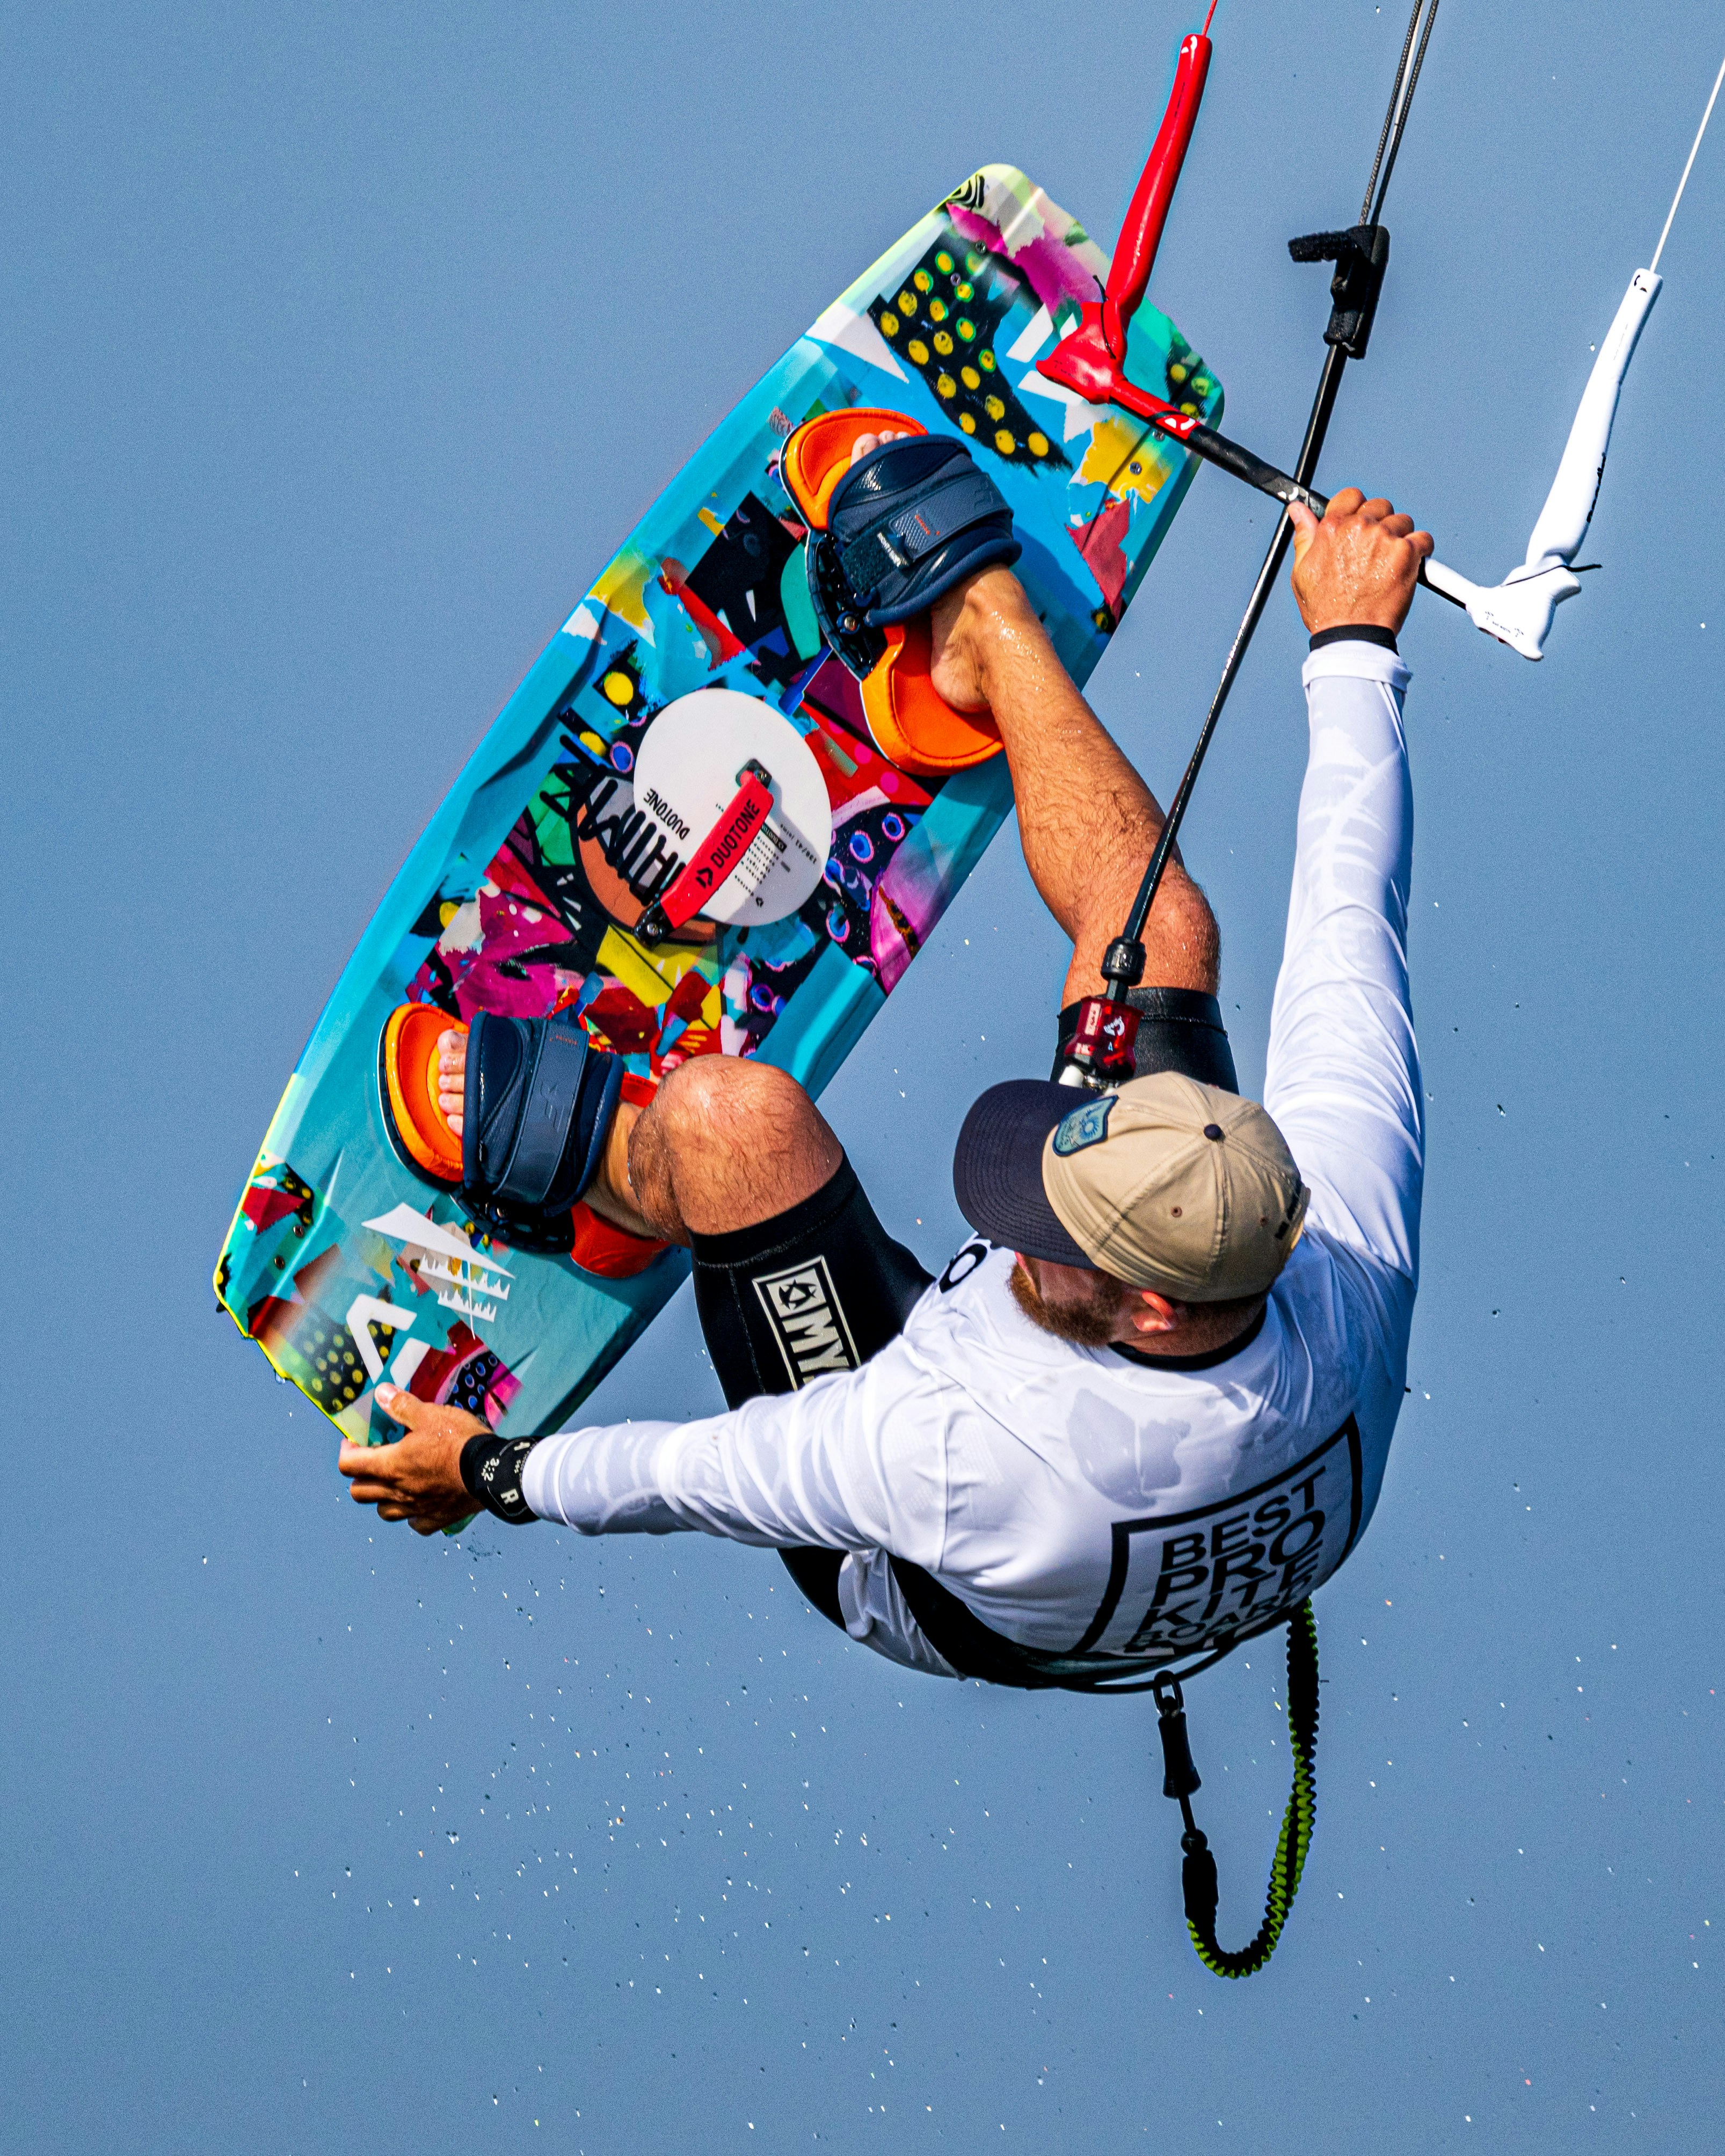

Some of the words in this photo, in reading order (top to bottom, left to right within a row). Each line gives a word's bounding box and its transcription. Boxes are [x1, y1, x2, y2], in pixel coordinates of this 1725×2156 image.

[642, 788, 691, 841] DUOTONE
[711, 798, 761, 869] DUOTONE
[782, 1306, 850, 1384] MY
[1150, 1510, 1326, 1608] PRO
[1160, 1465, 1326, 1574] BEST
[1134, 1538, 1323, 1637] KITE
